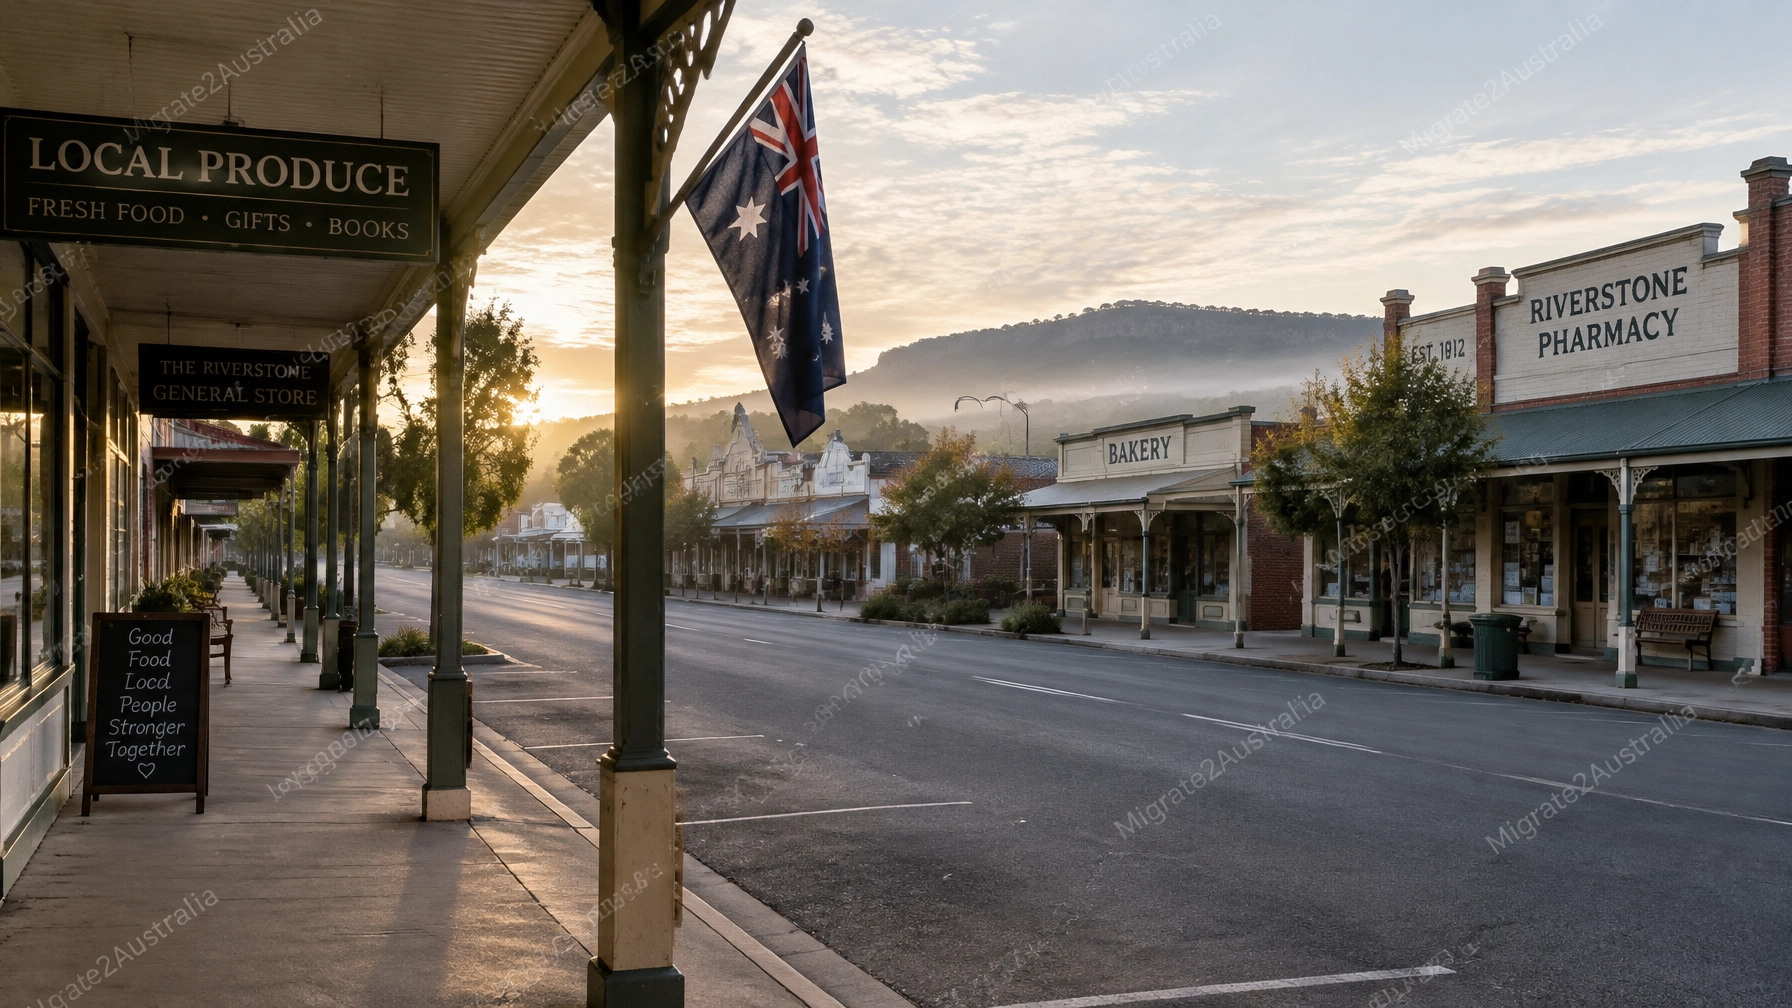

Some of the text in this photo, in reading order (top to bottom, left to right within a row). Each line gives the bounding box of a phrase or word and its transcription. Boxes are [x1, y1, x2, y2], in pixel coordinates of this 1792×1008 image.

[28, 137, 410, 197] LOCAL PRODUCE
[28, 197, 410, 240] FRESH FOOD GIFTS BOOKS
[1530, 266, 1688, 324] RIVERSTONE
[1538, 308, 1680, 358] PHARMACY
[160, 360, 312, 380] THE RIVERSTONE
[153, 385, 317, 406] GENERAL STORE
[1108, 435, 1172, 465] BAKERY
[128, 627, 174, 645] Good
[128, 650, 172, 667] Food
[119, 695, 177, 718] People
[108, 719, 186, 739] Stronger
[105, 741, 186, 762] Together
